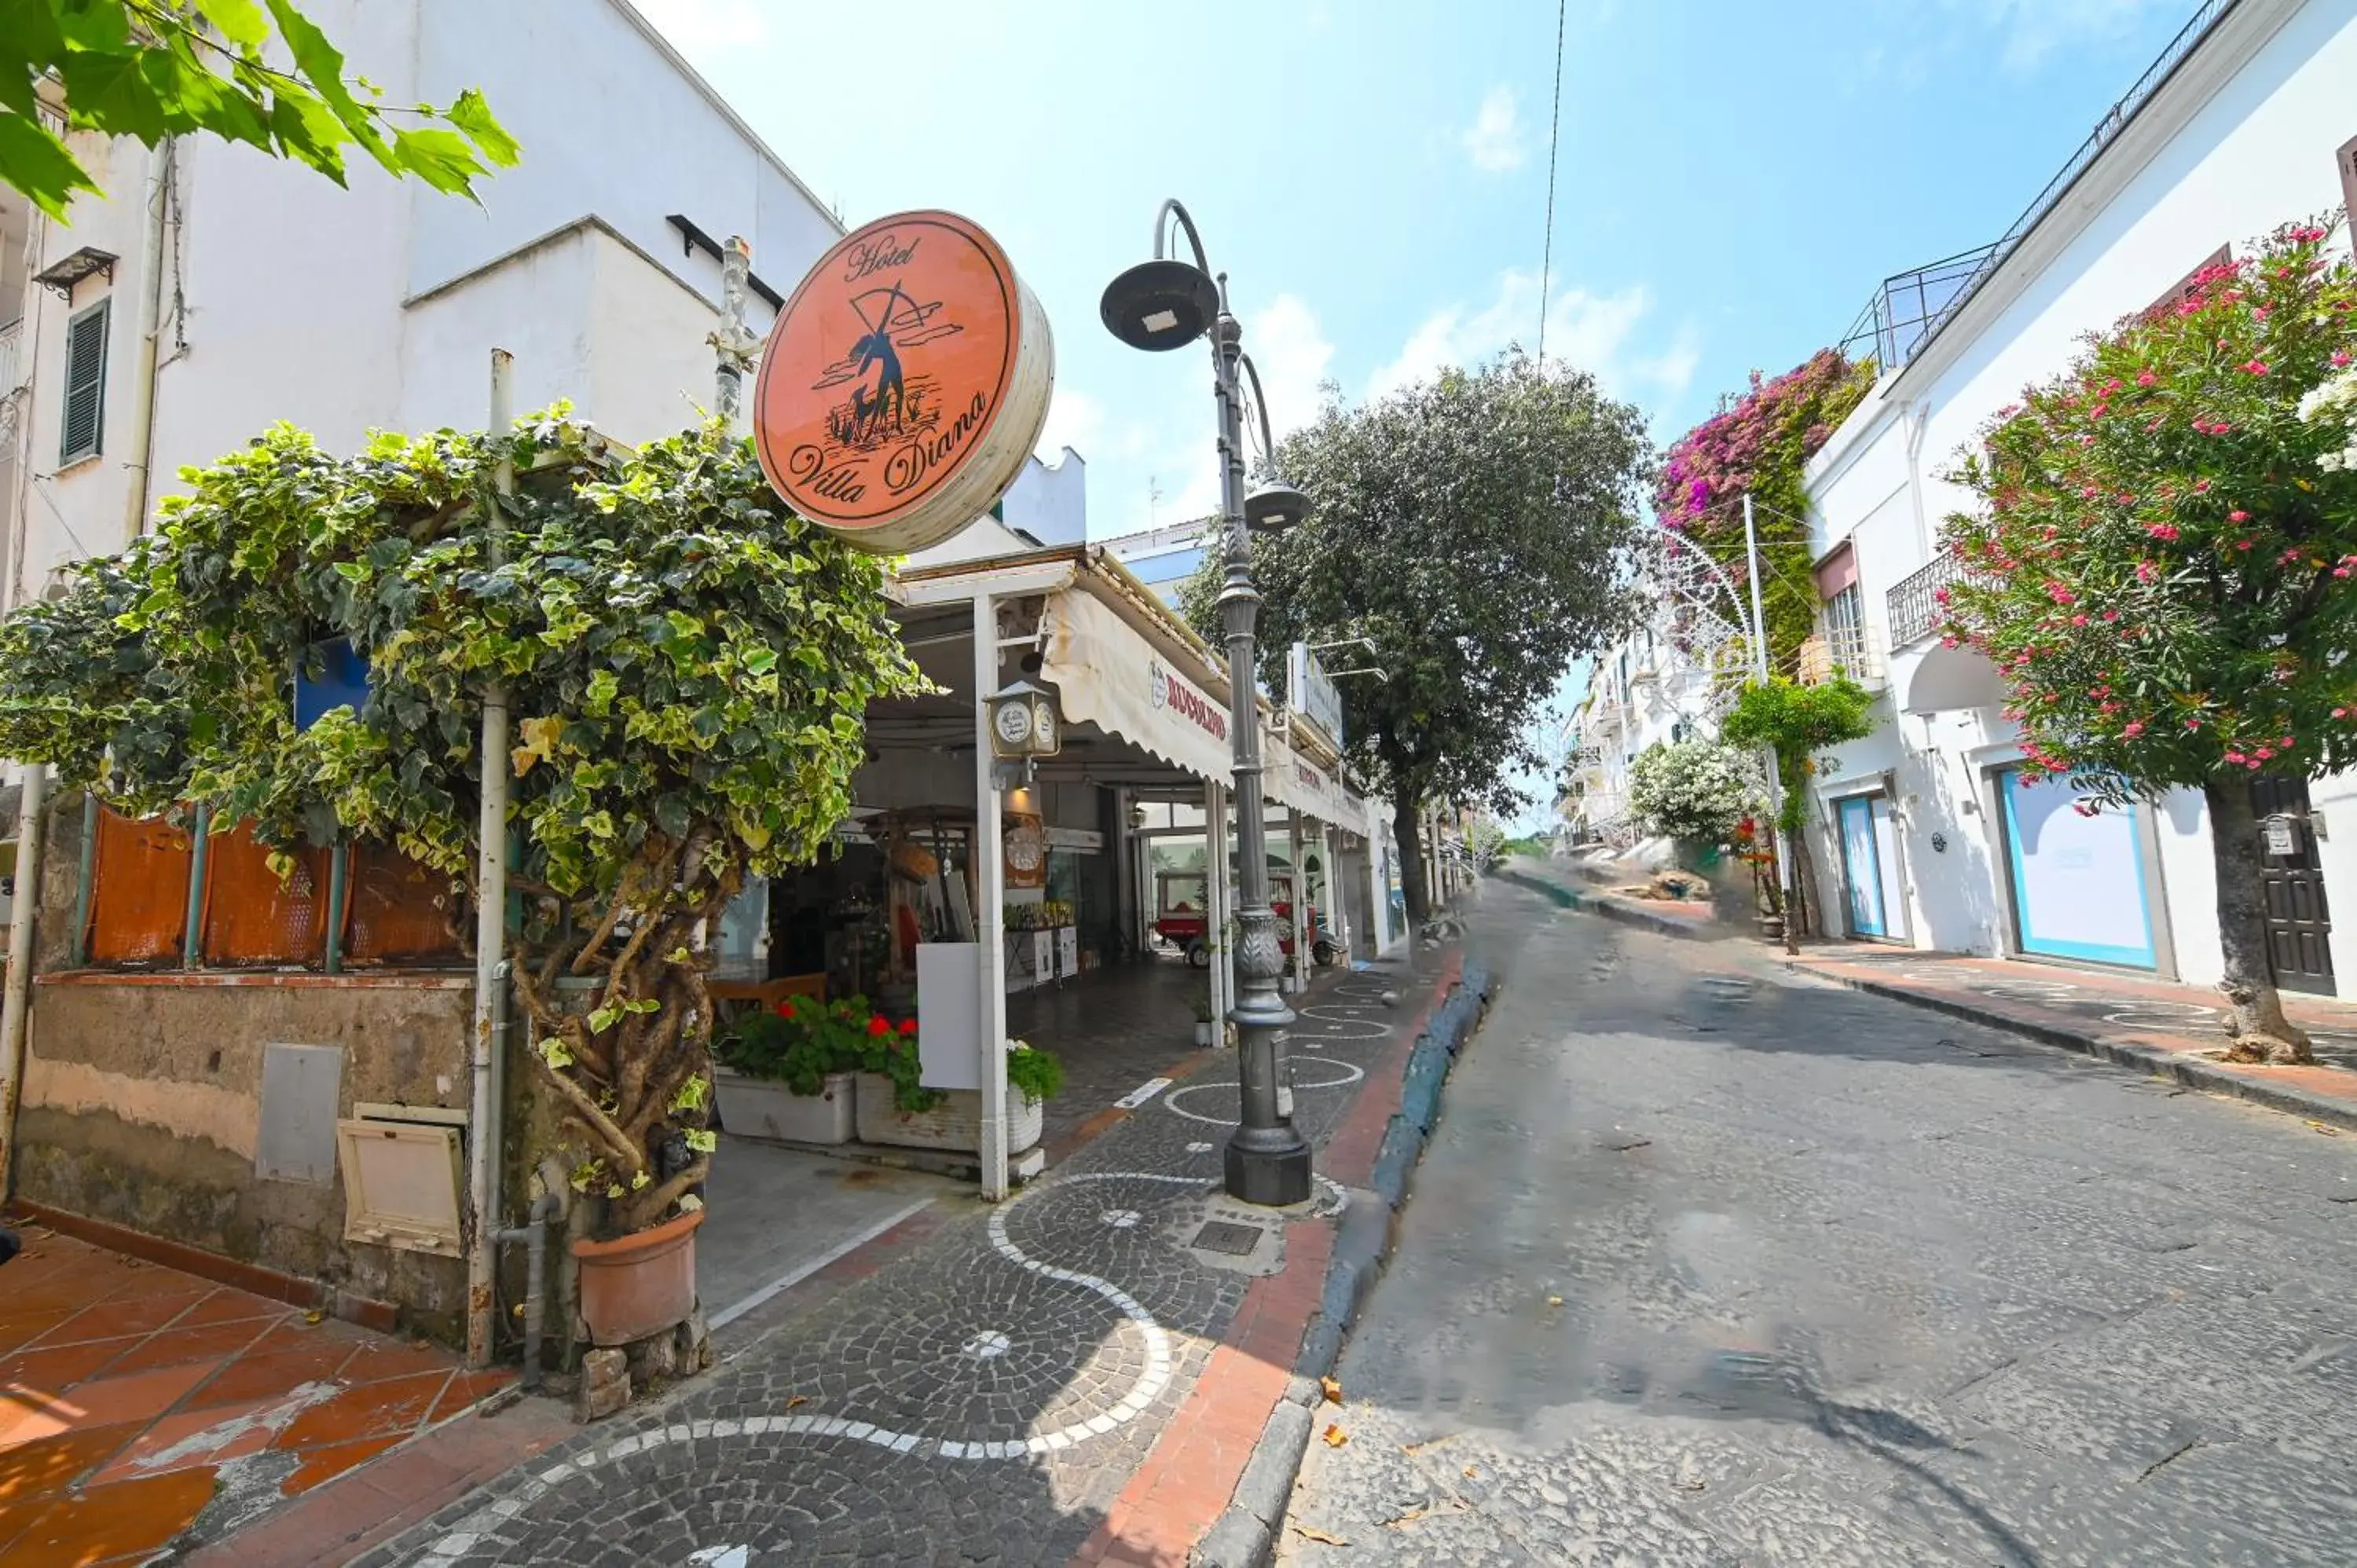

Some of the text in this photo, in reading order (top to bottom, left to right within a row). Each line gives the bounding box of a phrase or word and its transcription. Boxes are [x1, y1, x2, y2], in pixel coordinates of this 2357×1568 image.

[844, 235, 922, 283] Hotel
[790, 390, 986, 503] Villa Diana
